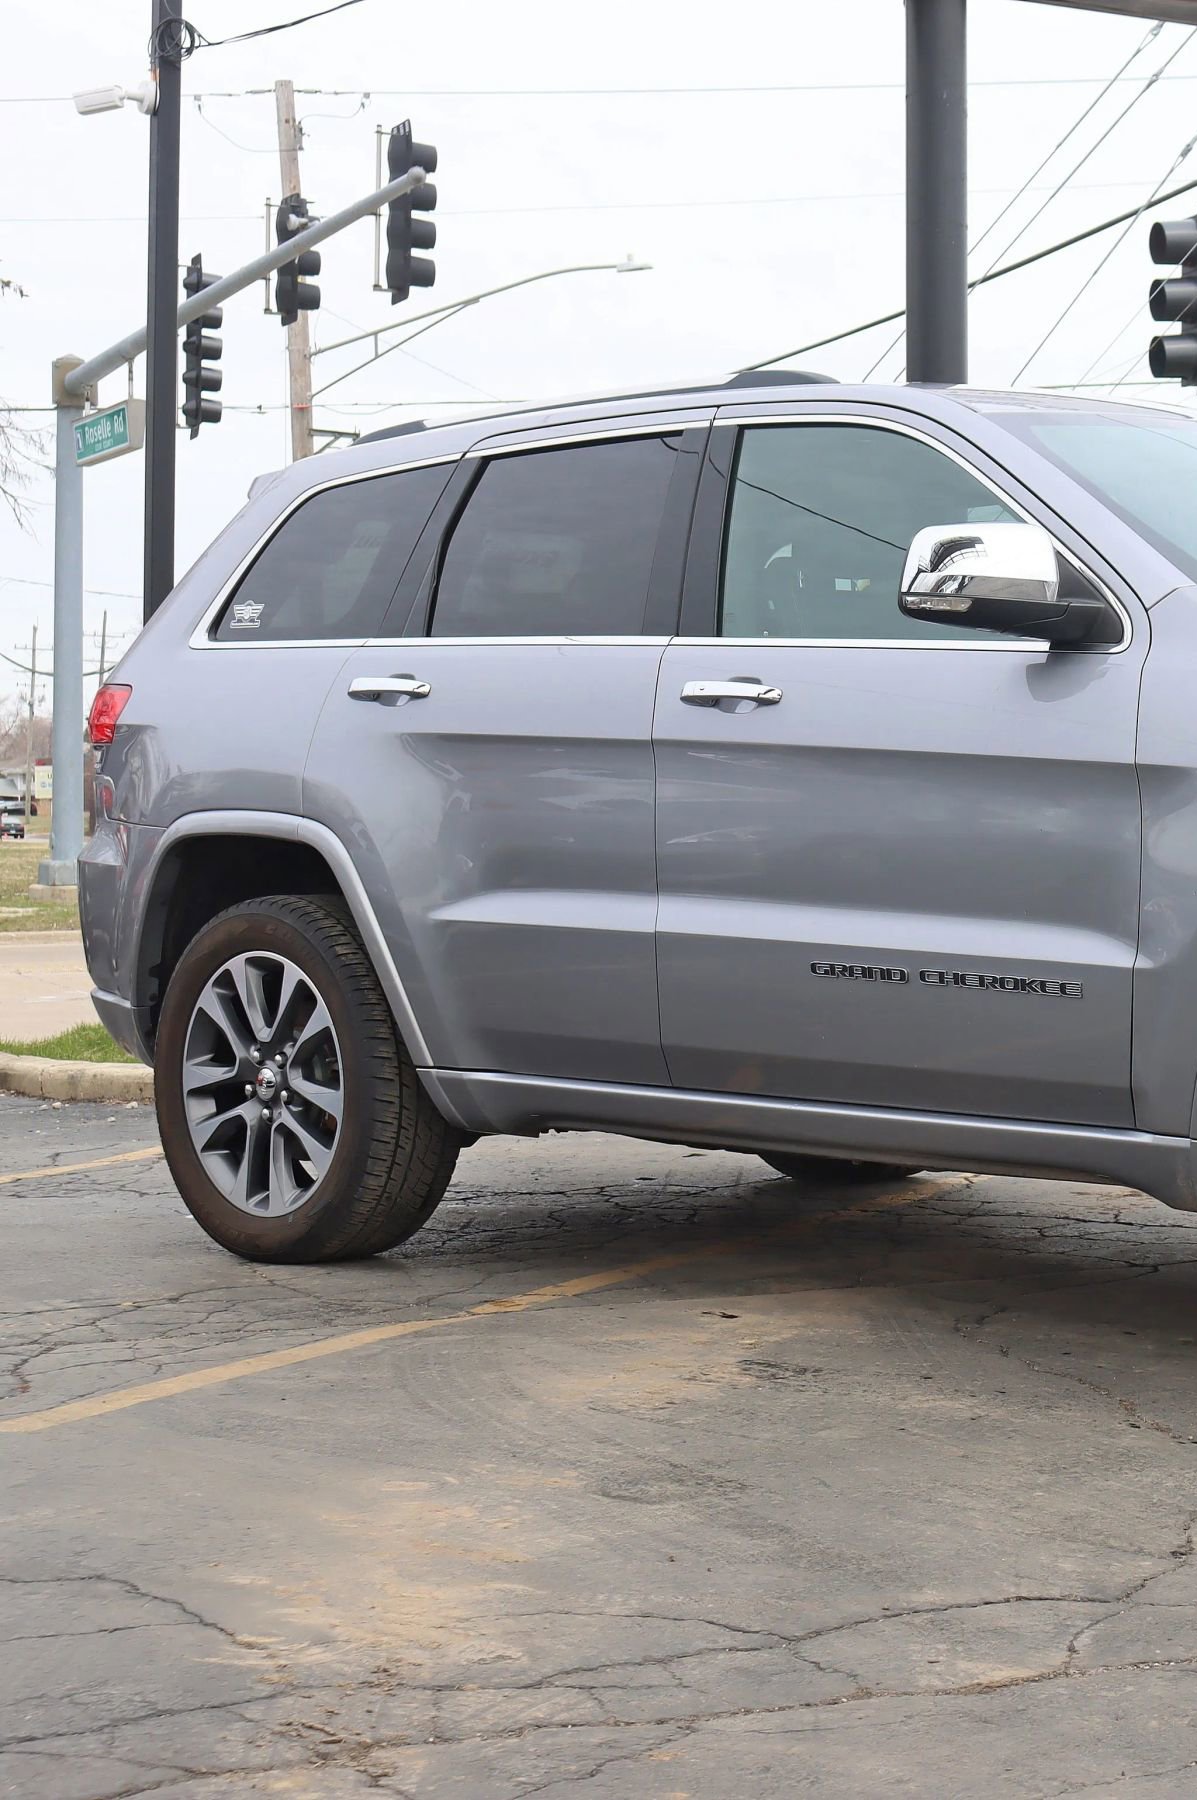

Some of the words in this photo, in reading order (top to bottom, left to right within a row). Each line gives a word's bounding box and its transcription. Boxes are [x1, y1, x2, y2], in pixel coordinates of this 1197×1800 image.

[85, 417, 112, 445] Roselle
[114, 411, 124, 434] Rd
[810, 961, 909, 984] GRAND
[919, 969, 1083, 998] CHEROKEE
